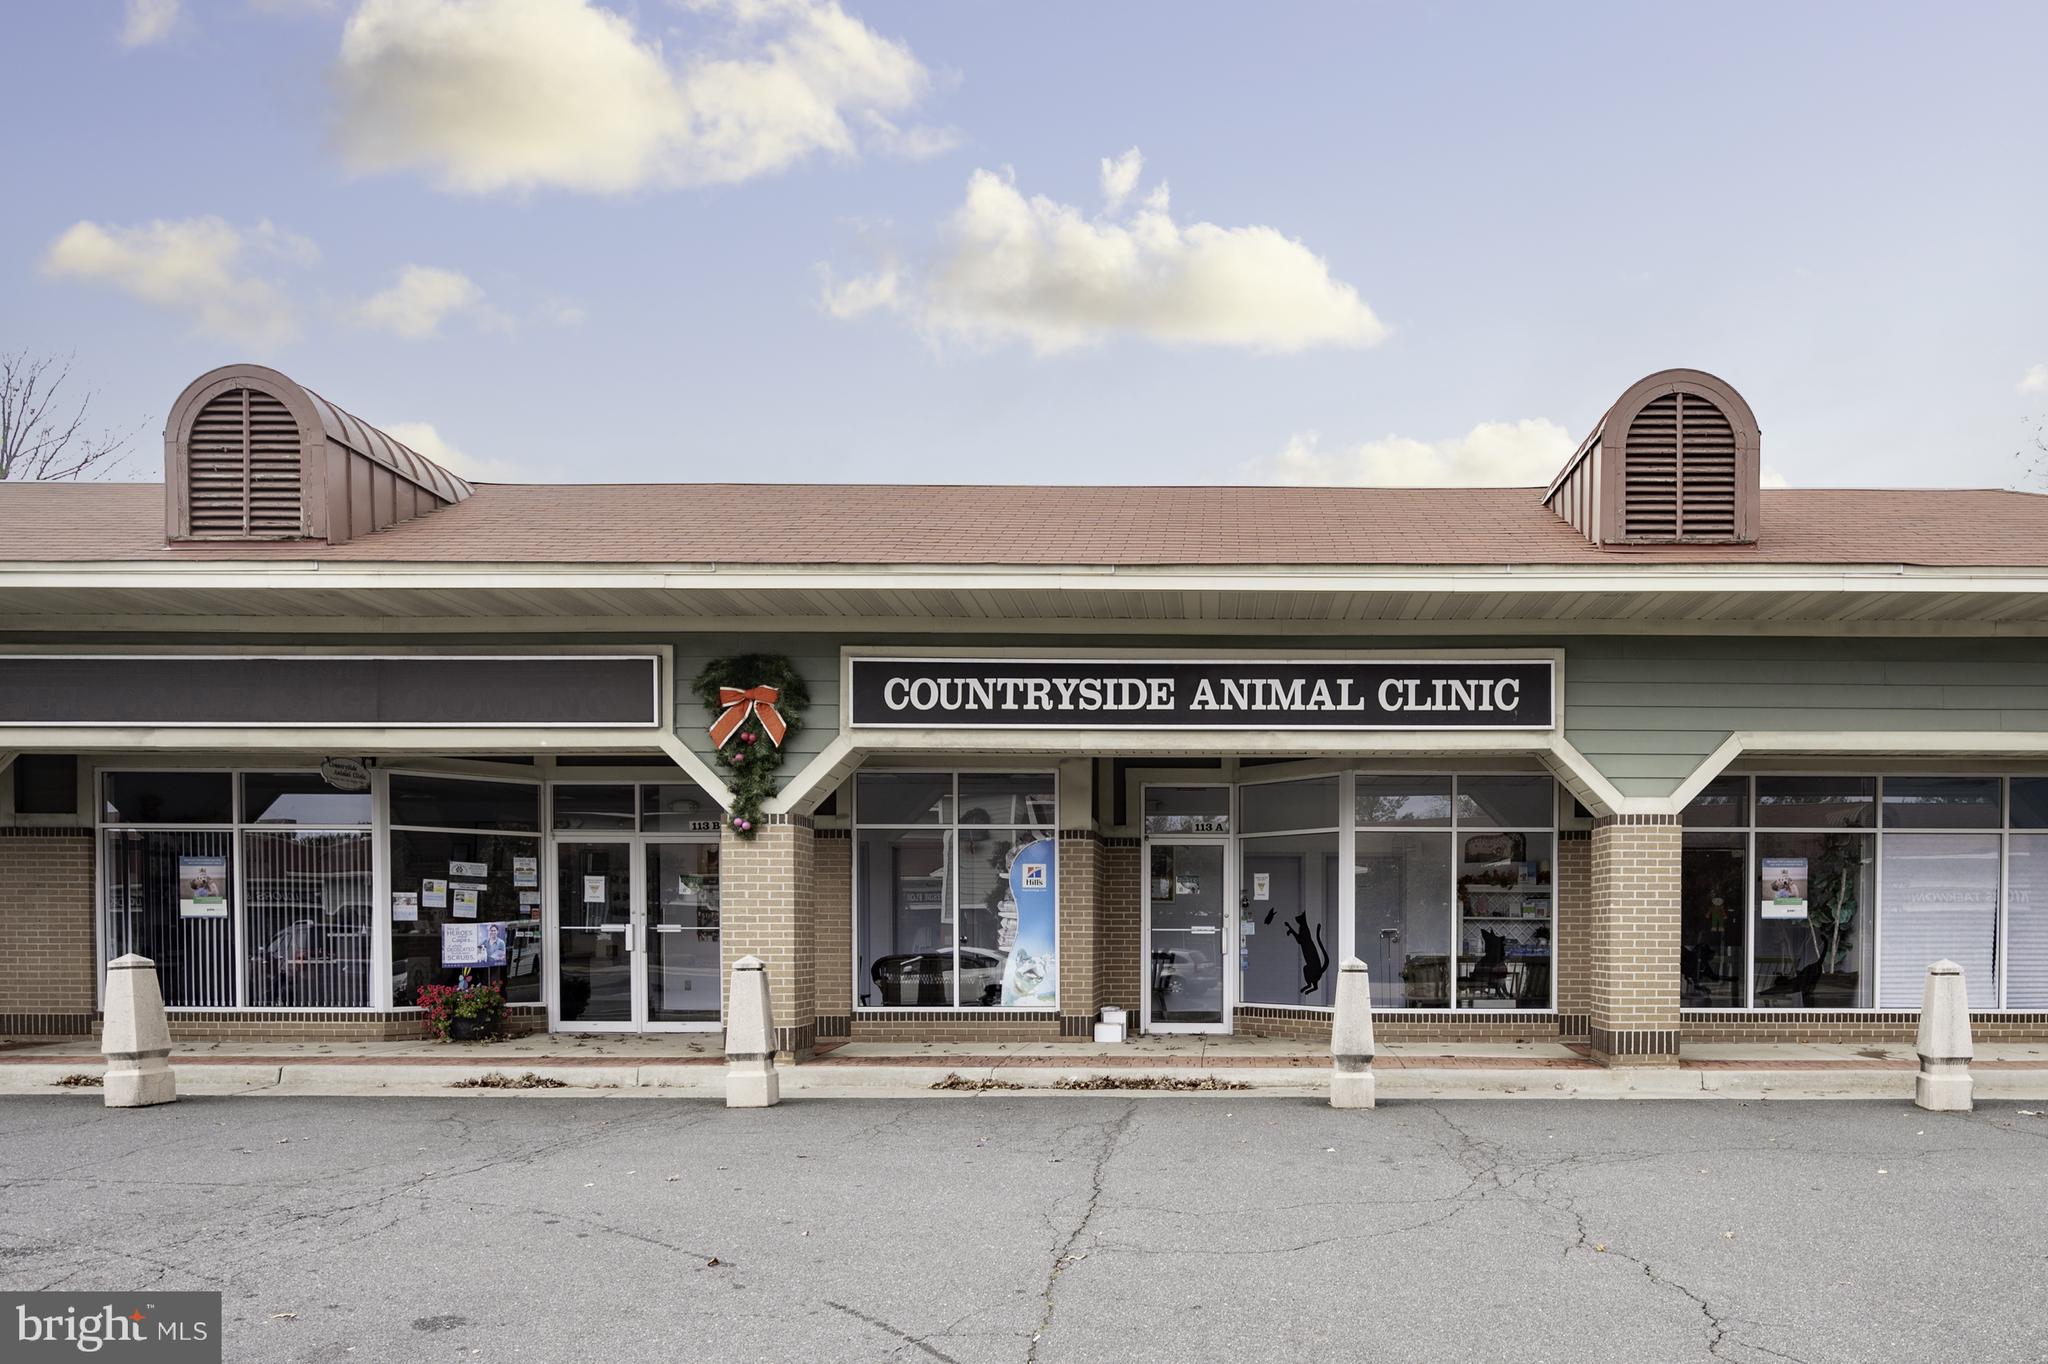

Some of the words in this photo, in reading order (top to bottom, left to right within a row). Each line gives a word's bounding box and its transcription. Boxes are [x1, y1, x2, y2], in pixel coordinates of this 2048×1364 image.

[883, 677, 1175, 711] COUNTRYSIDE
[1189, 678, 1365, 711] ANIMAL
[1378, 678, 1520, 712] CLINIC
[692, 821, 710, 831] 113
[711, 821, 721, 830] B
[1195, 823, 1213, 832] 113
[1215, 823, 1224, 832] A
[1025, 878, 1044, 886] Hill's
